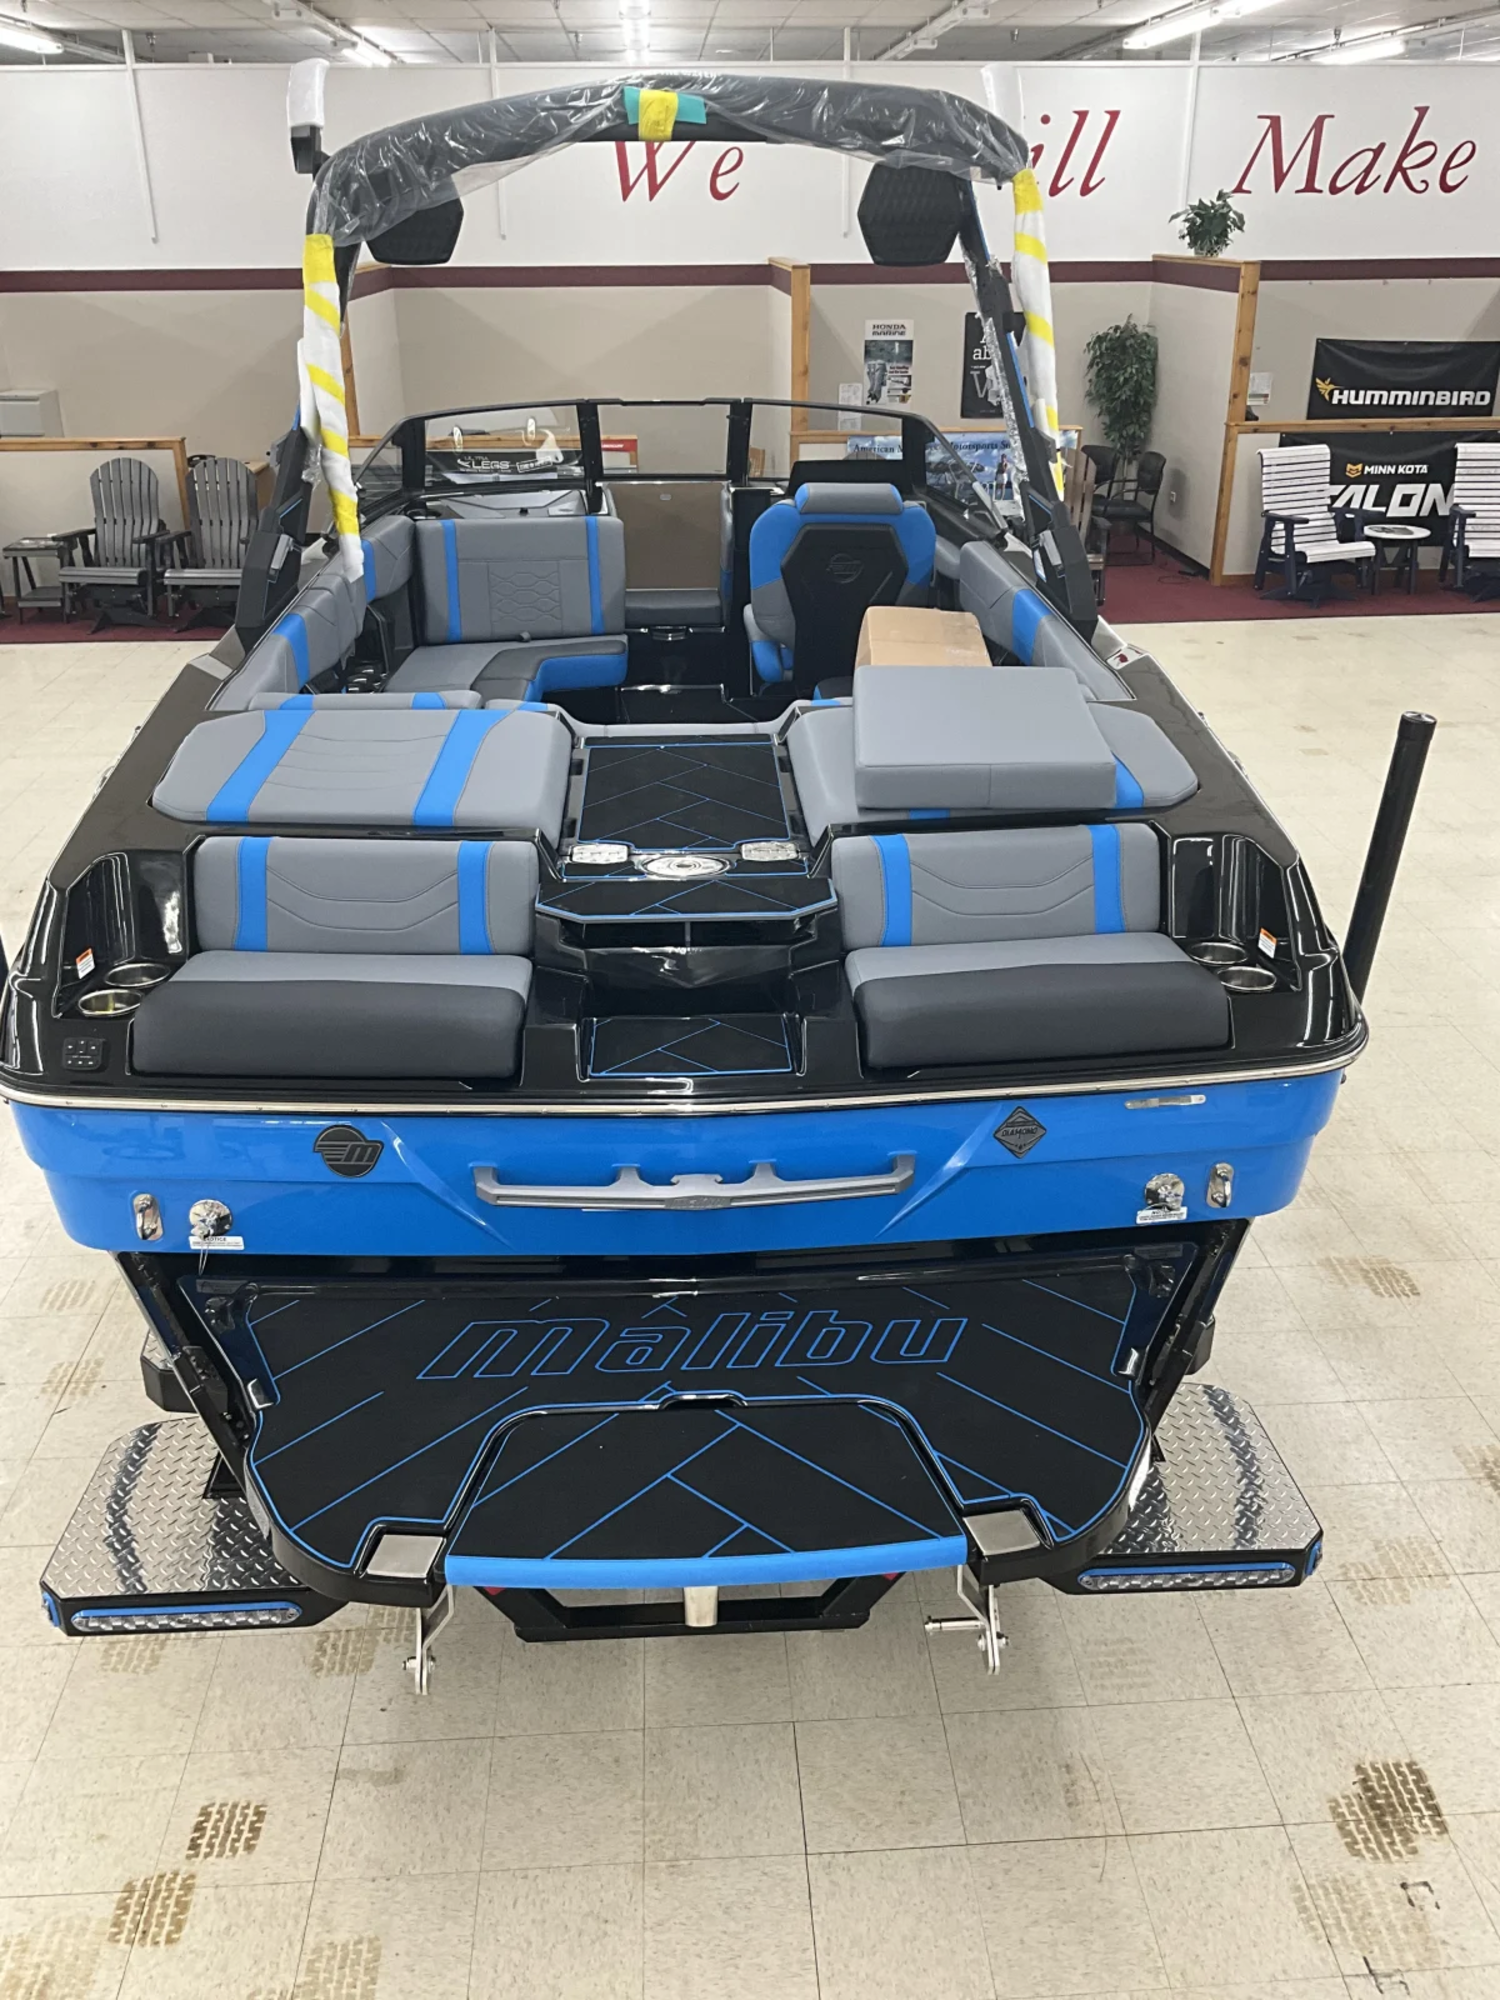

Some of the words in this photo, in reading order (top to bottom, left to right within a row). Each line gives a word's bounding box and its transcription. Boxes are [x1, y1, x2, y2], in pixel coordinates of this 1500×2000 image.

[1030, 109, 1122, 198] ill
[1231, 105, 1477, 195] Make
[1331, 389, 1491, 406] HUMMINBIRD
[853, 443, 895, 453] American
[950, 442, 998, 452] otorsports
[1363, 464, 1397, 475] MINN
[1397, 464, 1429, 474] KOTA
[416, 1310, 968, 1380] malibu
